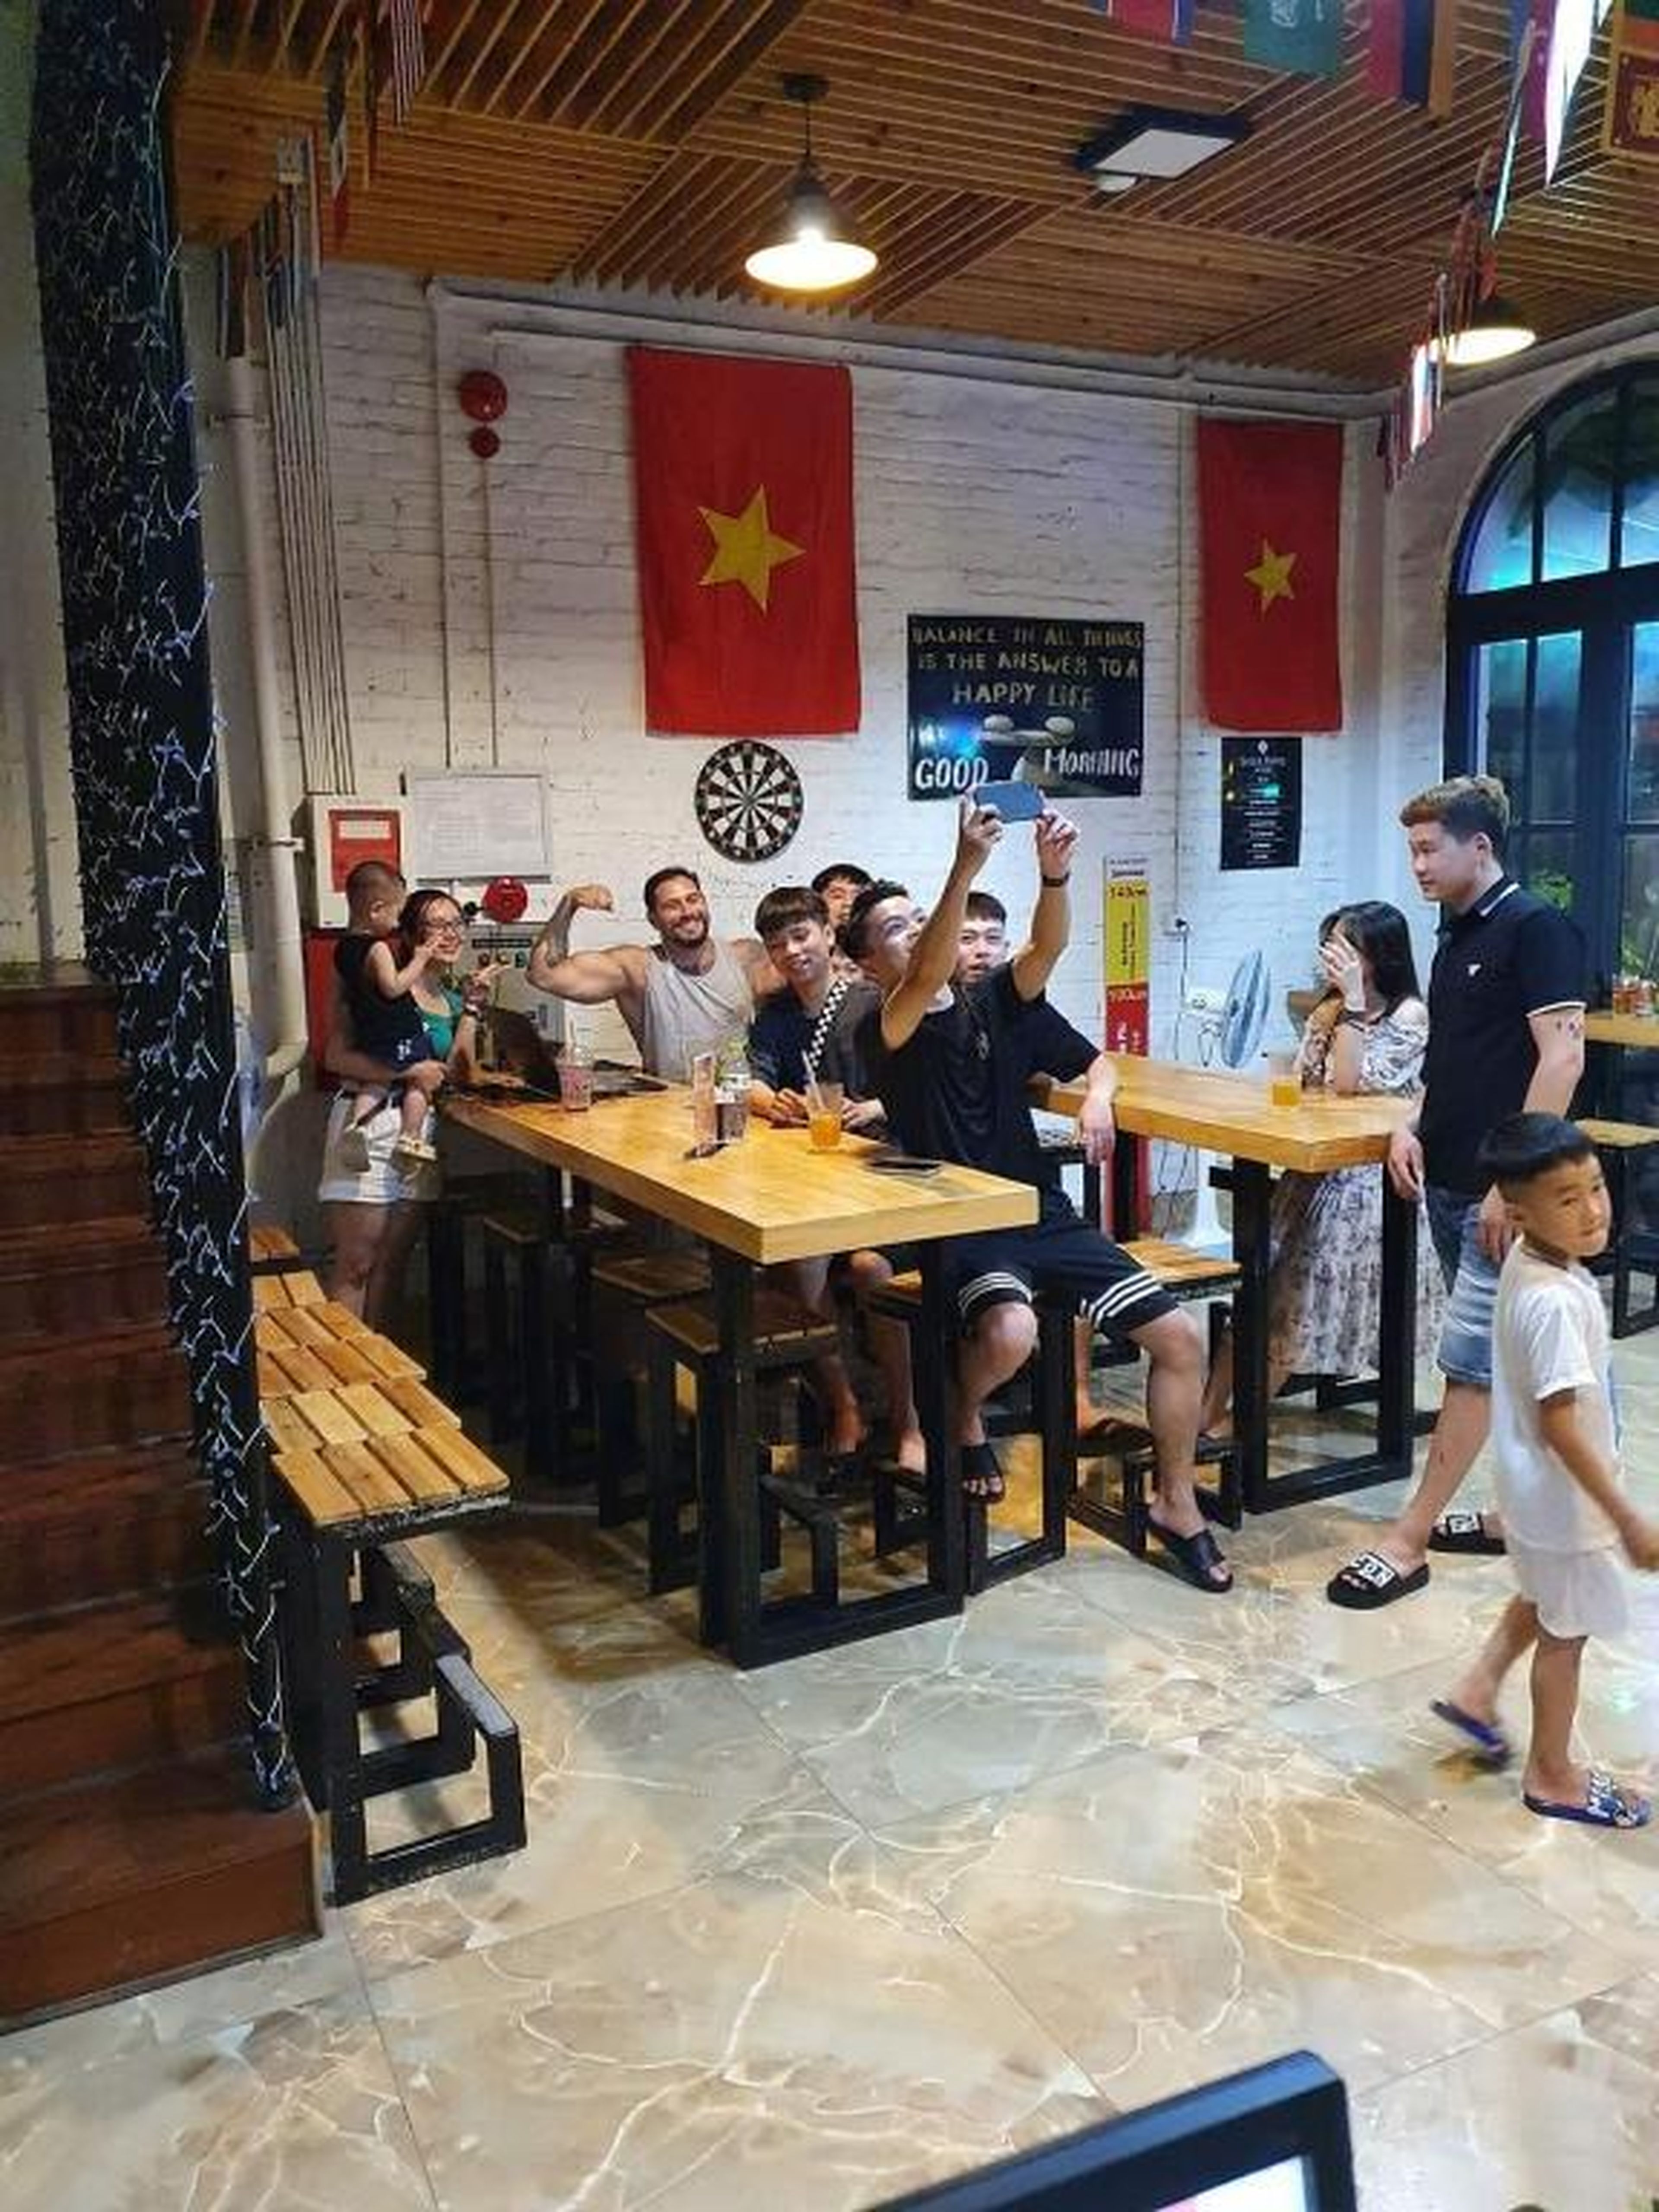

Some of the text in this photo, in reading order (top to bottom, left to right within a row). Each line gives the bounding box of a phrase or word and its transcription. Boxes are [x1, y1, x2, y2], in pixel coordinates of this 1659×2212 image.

[912, 626, 1001, 644] BALANCE
[1014, 627, 1035, 645] IN
[1043, 628, 1072, 645] ALL
[918, 653, 937, 669] IS
[947, 653, 987, 669] THE
[998, 652, 1087, 677] ANSWER
[952, 683, 1035, 704] HAPPY
[915, 756, 989, 790] GOOD
